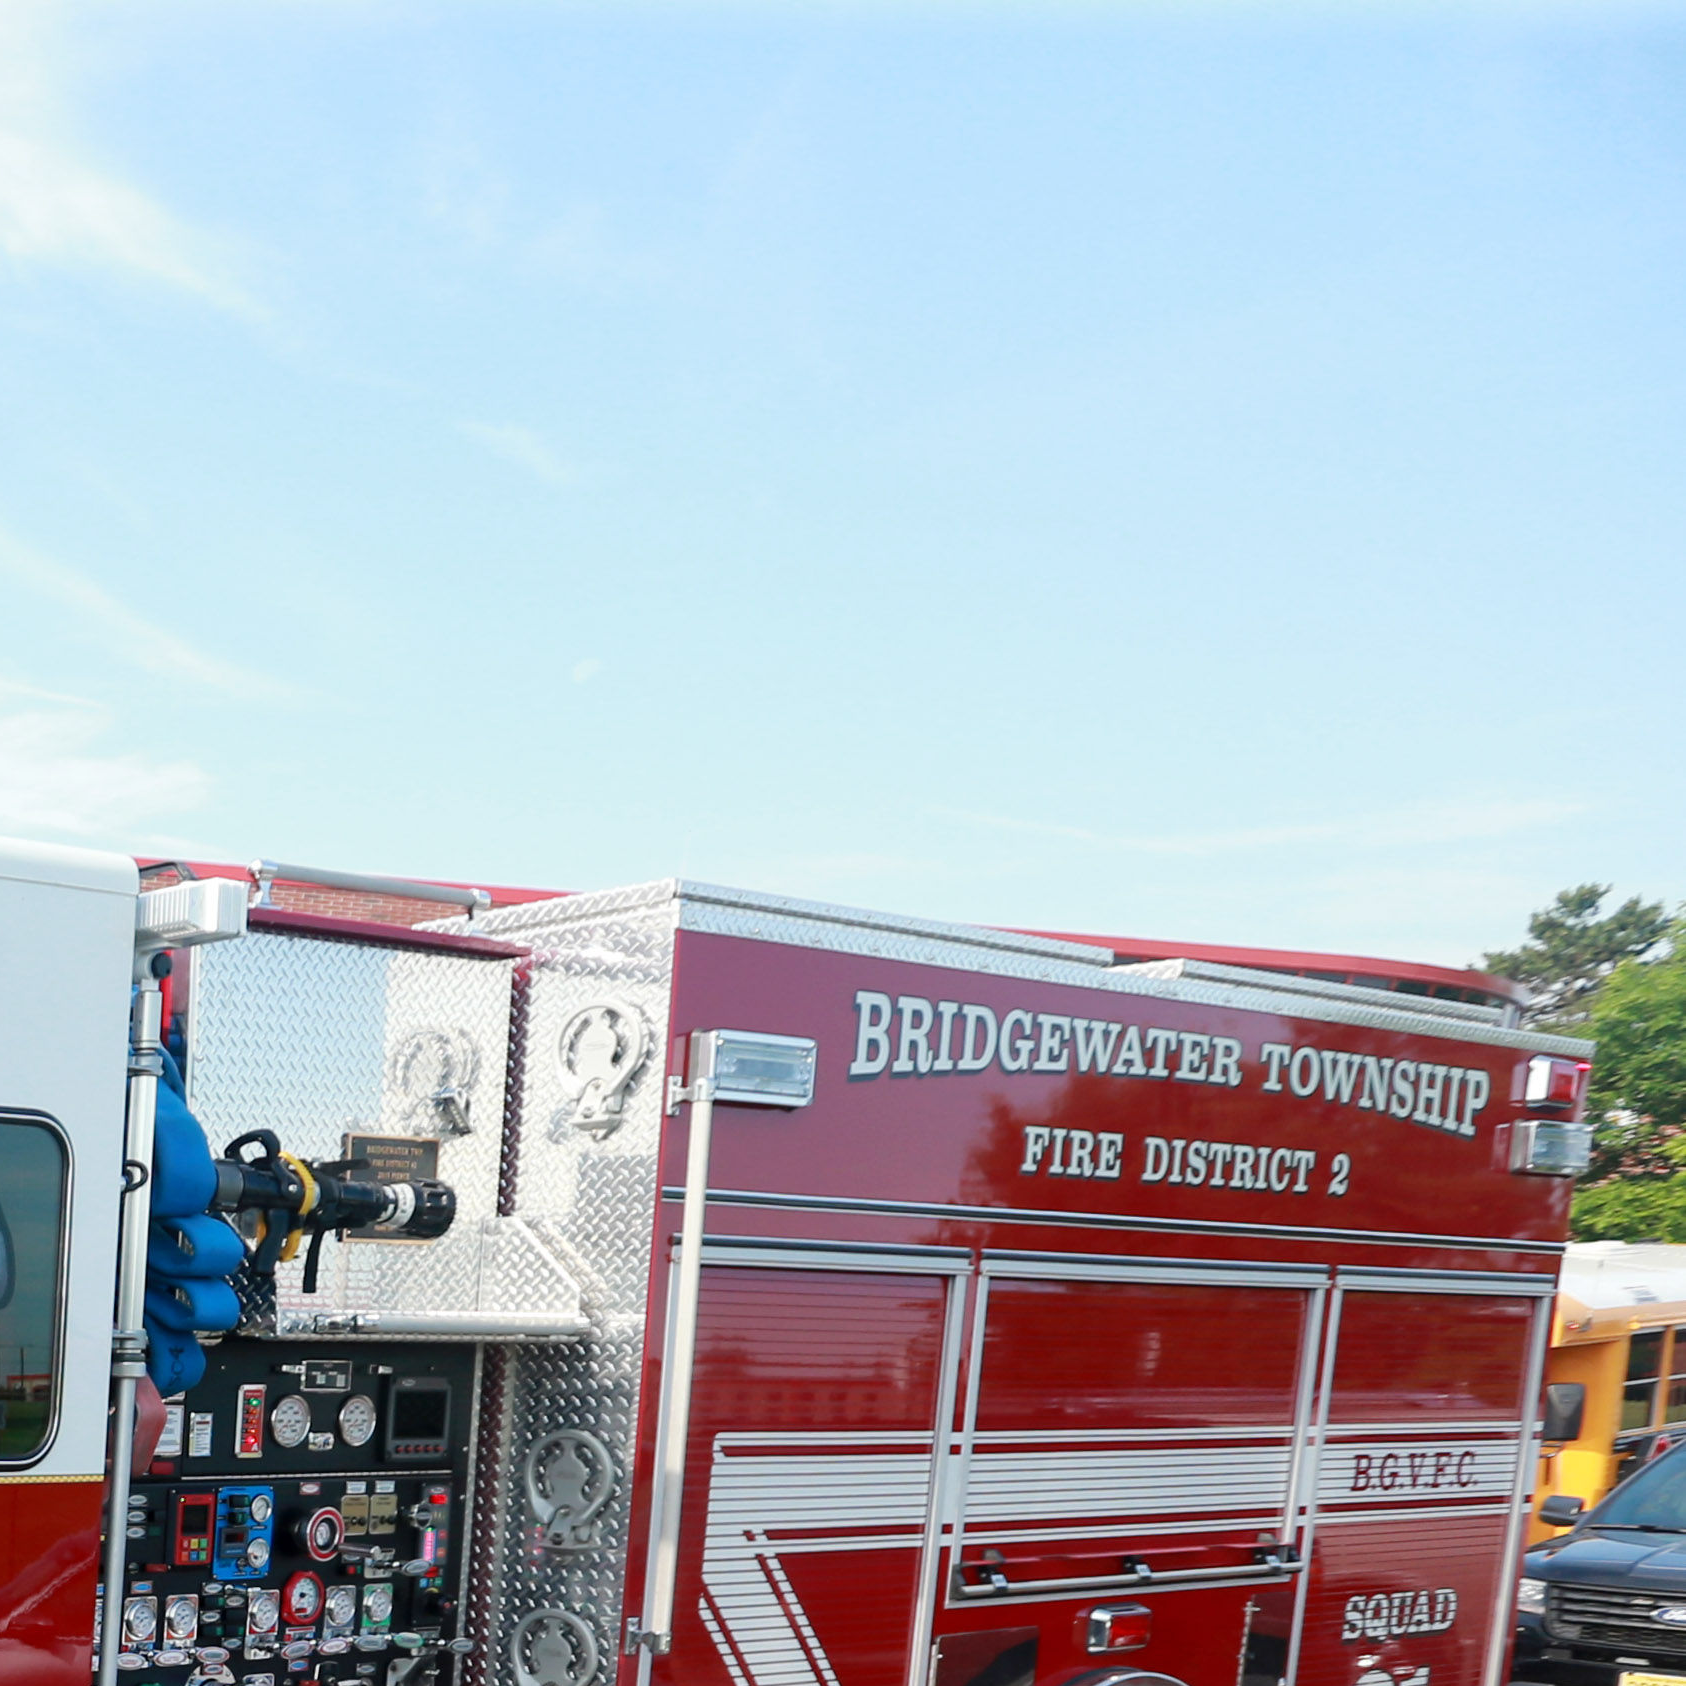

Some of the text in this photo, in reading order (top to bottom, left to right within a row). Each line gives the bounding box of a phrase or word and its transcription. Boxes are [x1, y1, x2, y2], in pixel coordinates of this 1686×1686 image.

[849, 990, 1491, 1137] BRIDGEWATER TOWNSHIP
[1019, 1126, 1351, 1196] FIRE DISTRICT 2
[1341, 1587, 1458, 1644] SQUAD
